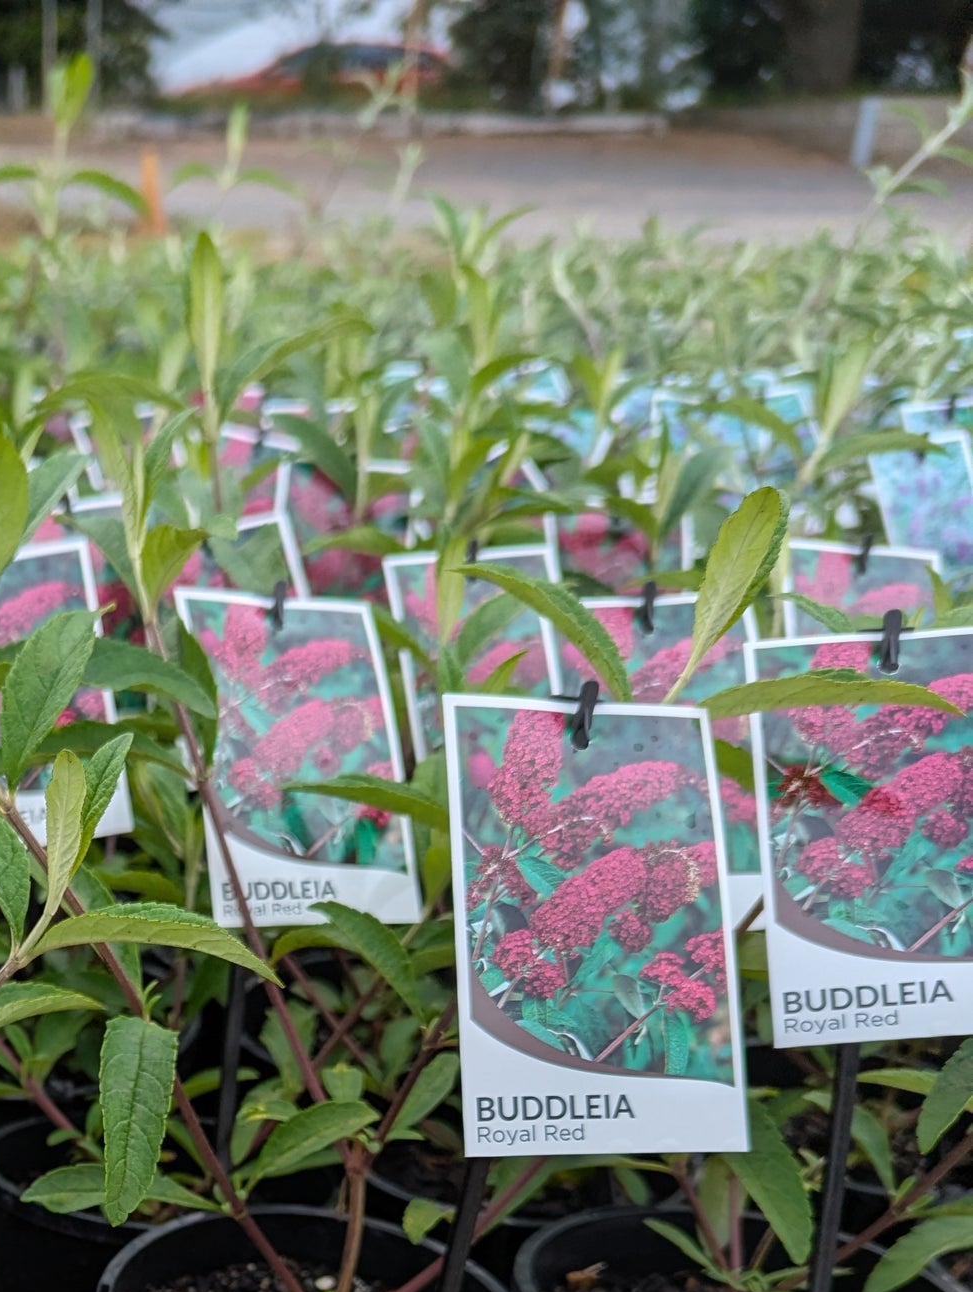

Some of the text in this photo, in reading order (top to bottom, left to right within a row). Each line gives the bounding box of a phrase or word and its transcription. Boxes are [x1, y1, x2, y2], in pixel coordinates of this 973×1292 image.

[782, 980, 954, 1014] BUDDLEIA
[784, 1010, 899, 1034] Royal Red
[476, 1094, 635, 1121] BUDDLEIA
[477, 1124, 585, 1146] Royal Red
